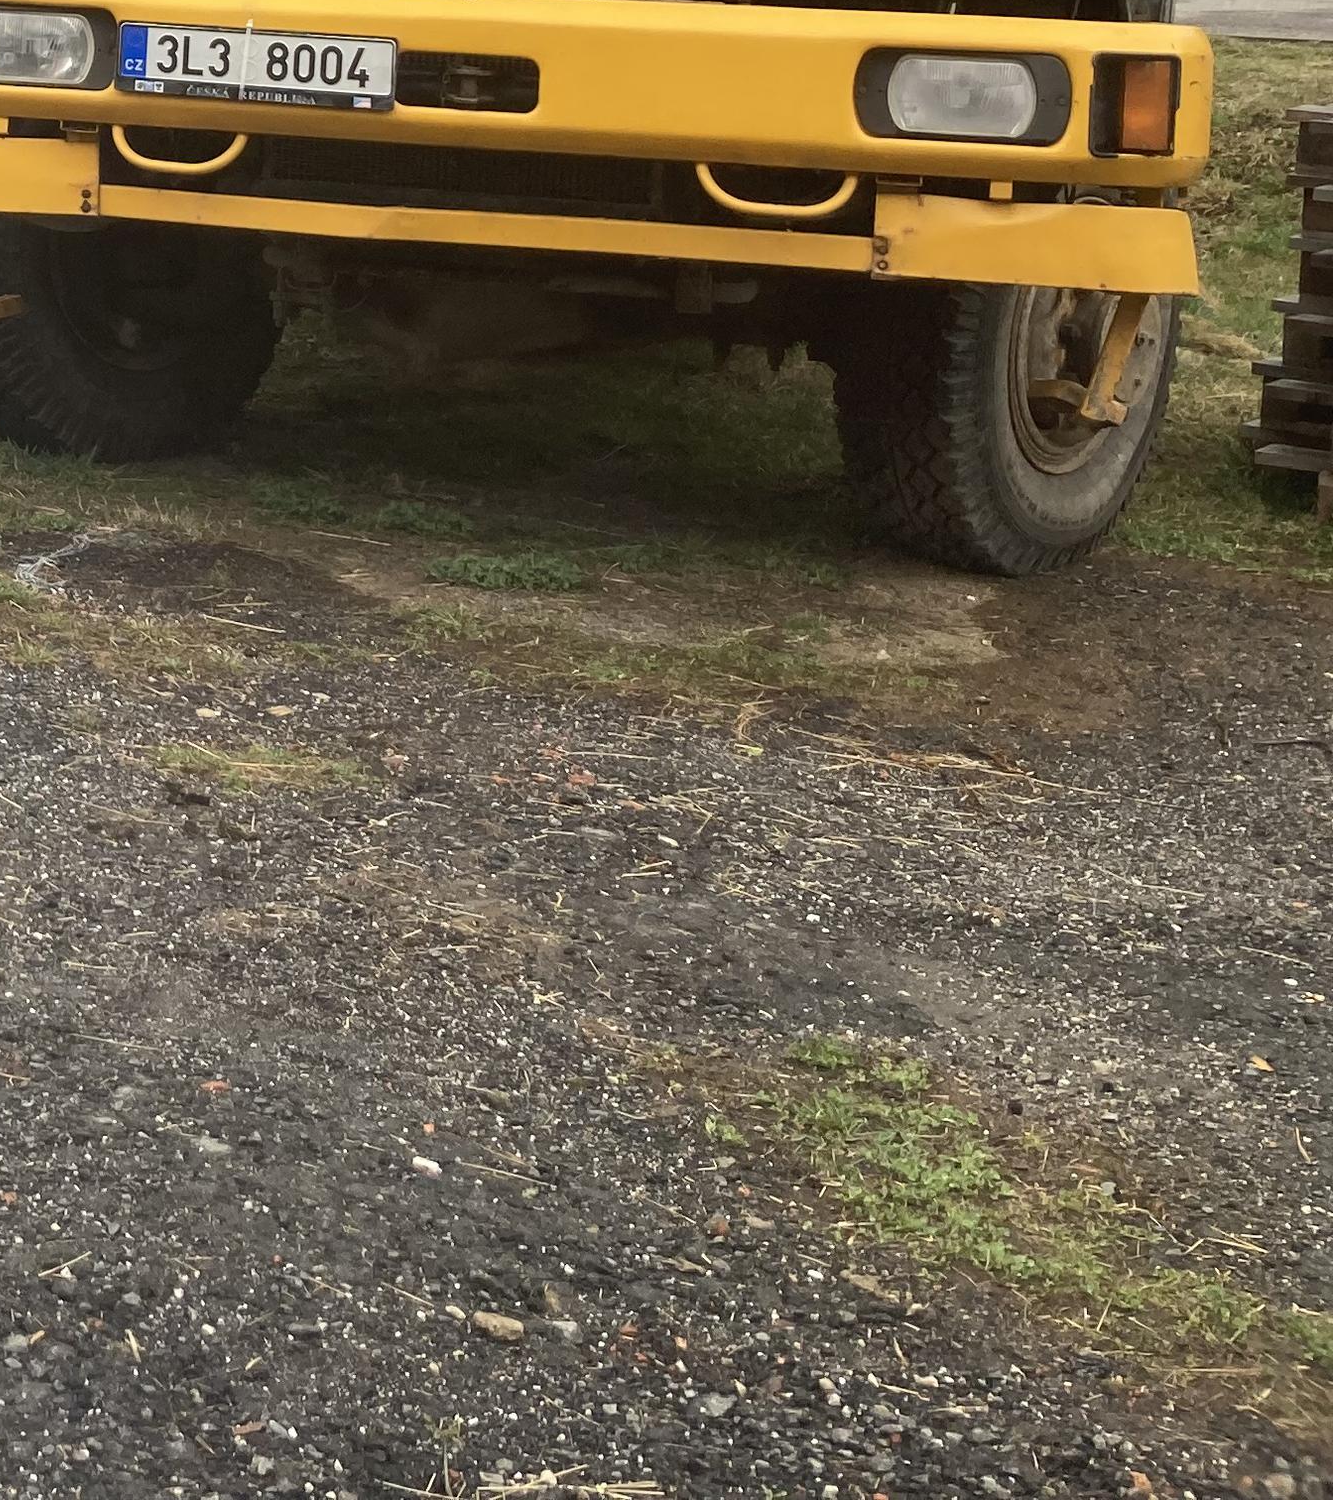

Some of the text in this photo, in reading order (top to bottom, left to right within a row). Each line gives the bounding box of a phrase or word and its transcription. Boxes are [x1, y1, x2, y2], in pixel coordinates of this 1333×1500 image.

[124, 58, 143, 72] CZ
[157, 35, 370, 88] 3L3 8004
[186, 84, 230, 98] ČESKÁ
